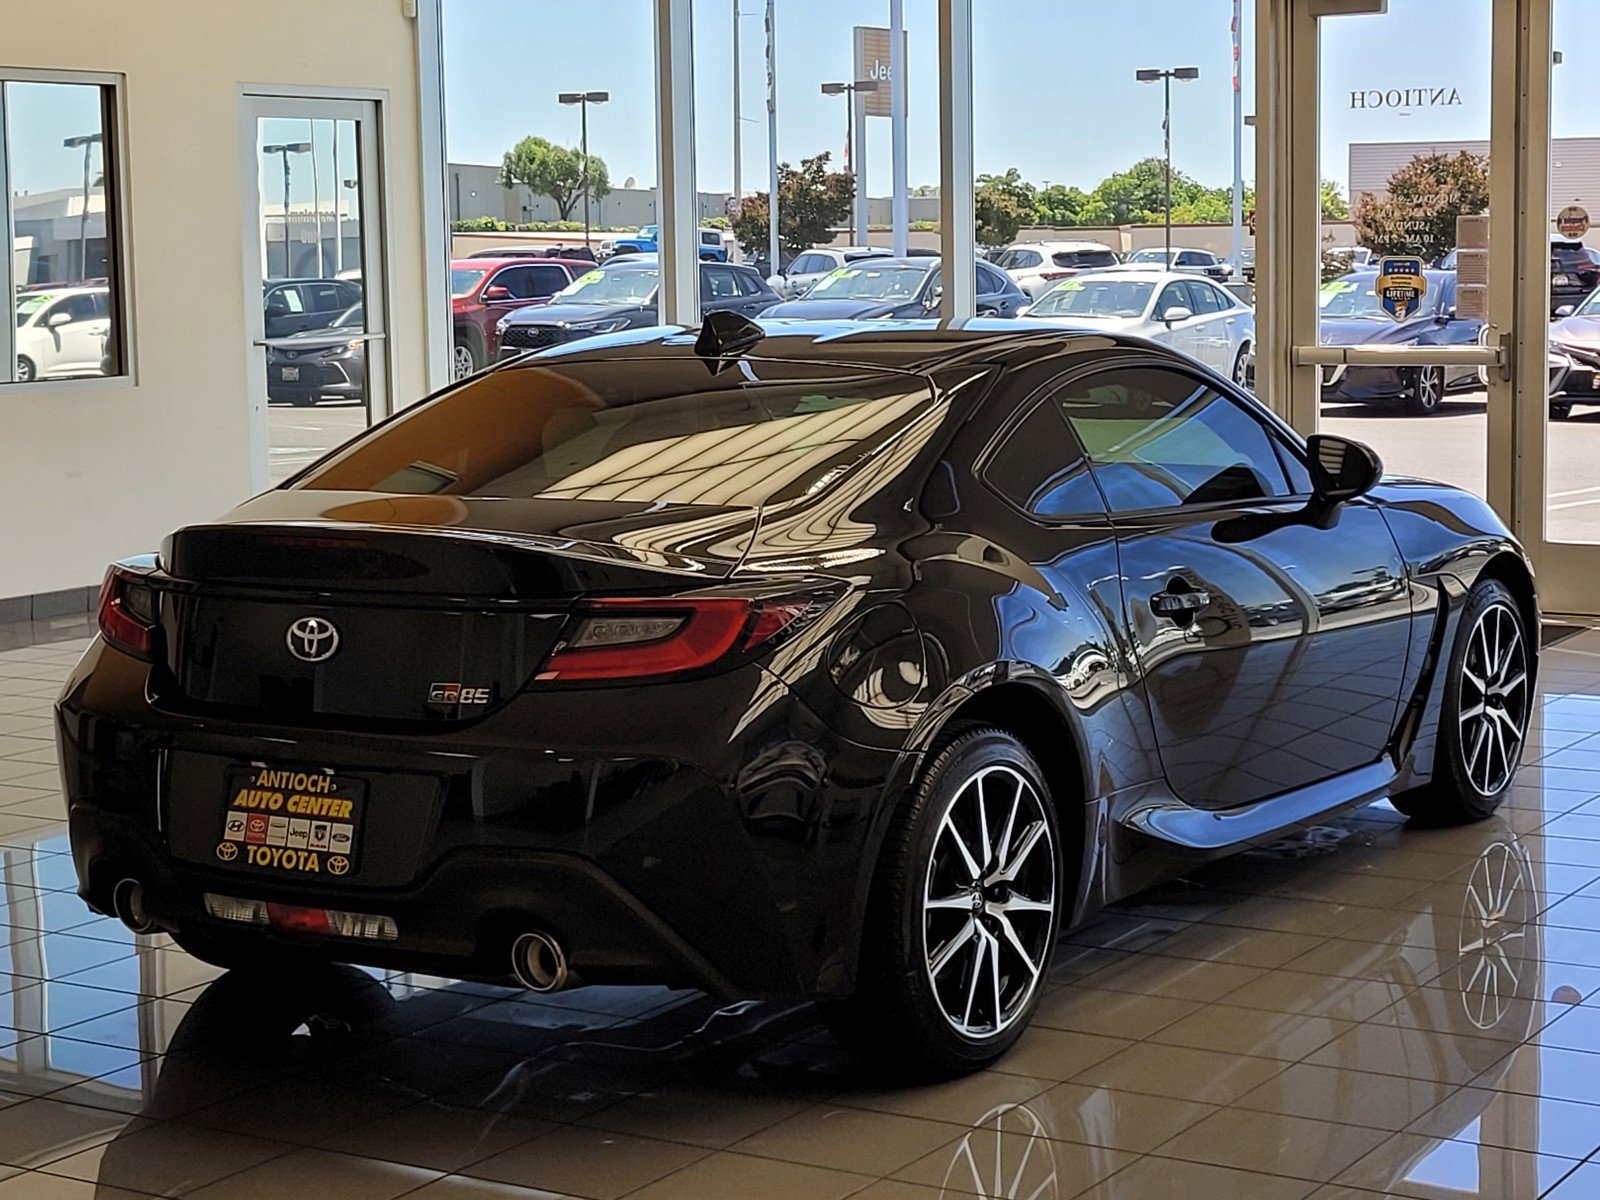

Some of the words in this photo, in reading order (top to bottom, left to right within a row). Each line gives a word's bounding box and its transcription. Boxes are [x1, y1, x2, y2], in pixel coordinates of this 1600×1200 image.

[870, 59, 893, 80] Jee
[256, 769, 331, 794] ANTIOCH
[232, 789, 284, 811] AUTO
[286, 794, 353, 819] CENTER
[289, 828, 308, 840] Jeep
[247, 845, 320, 872] TOYOTA
